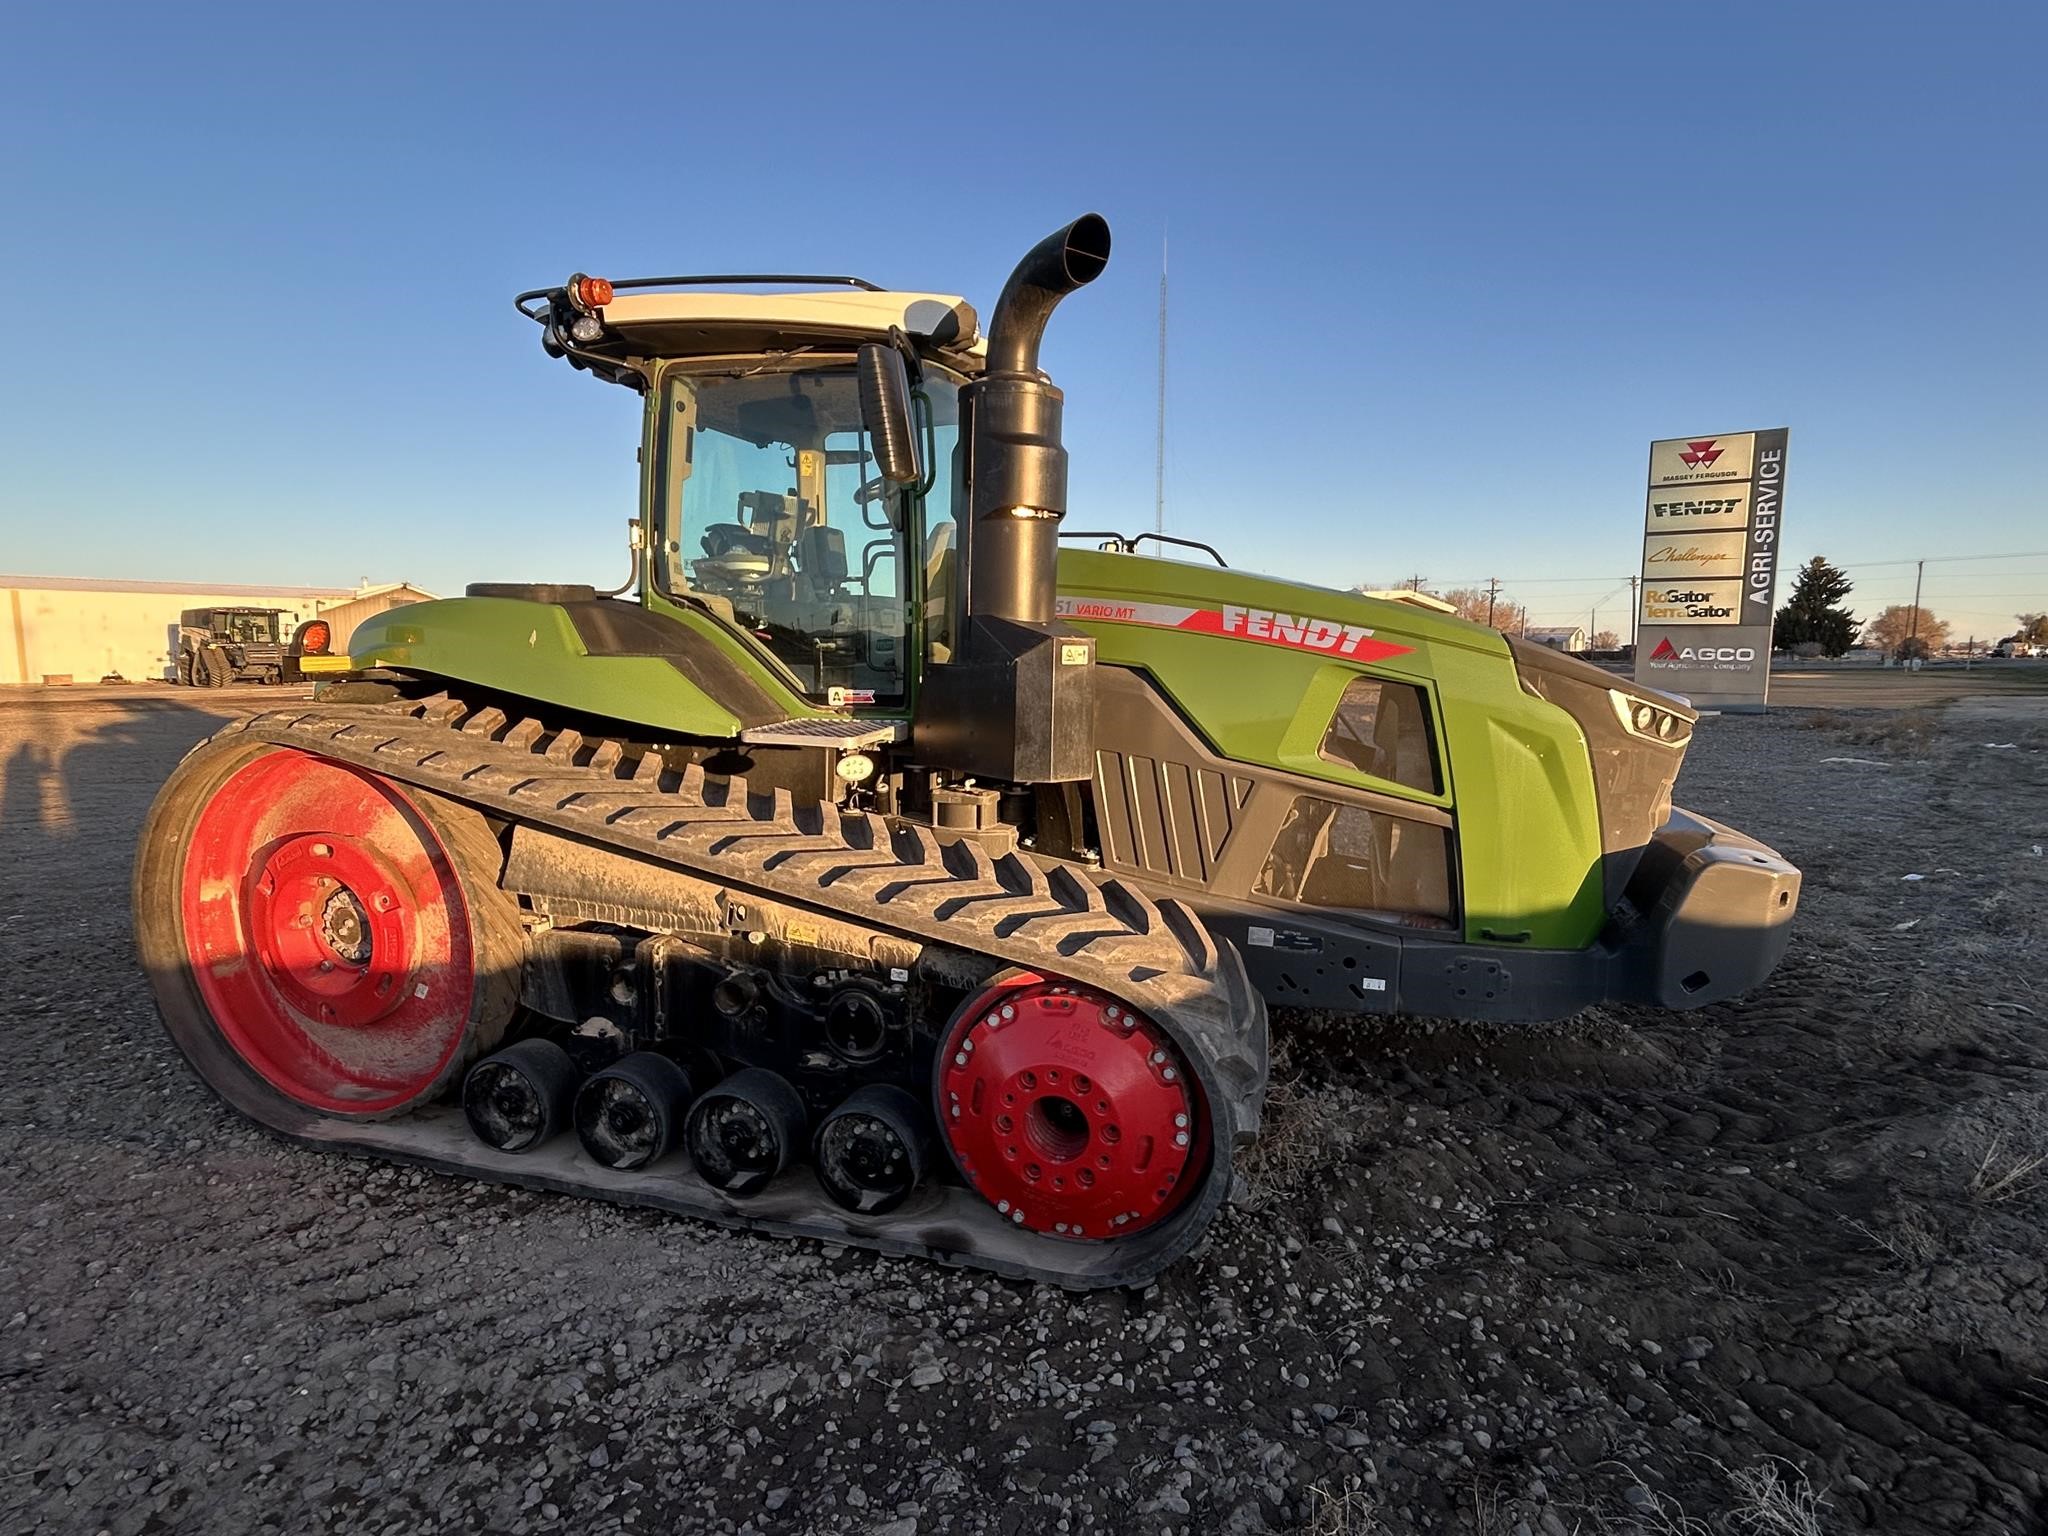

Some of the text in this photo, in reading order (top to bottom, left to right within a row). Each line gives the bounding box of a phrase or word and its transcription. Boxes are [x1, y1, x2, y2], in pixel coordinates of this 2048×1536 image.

[1695, 471, 1737, 479] FERGUSON
[1653, 498, 1742, 517] FENDT
[1749, 449, 1781, 604] AGRI-SERVICE
[1648, 547, 1739, 566] Challenger
[1646, 590, 1716, 603] RoGator
[1076, 603, 1113, 617] VARIO
[1115, 607, 1136, 619] MT
[1645, 604, 1736, 618] TerraGator
[1222, 604, 1375, 654] FENDT
[1680, 647, 1755, 661] AGCO
